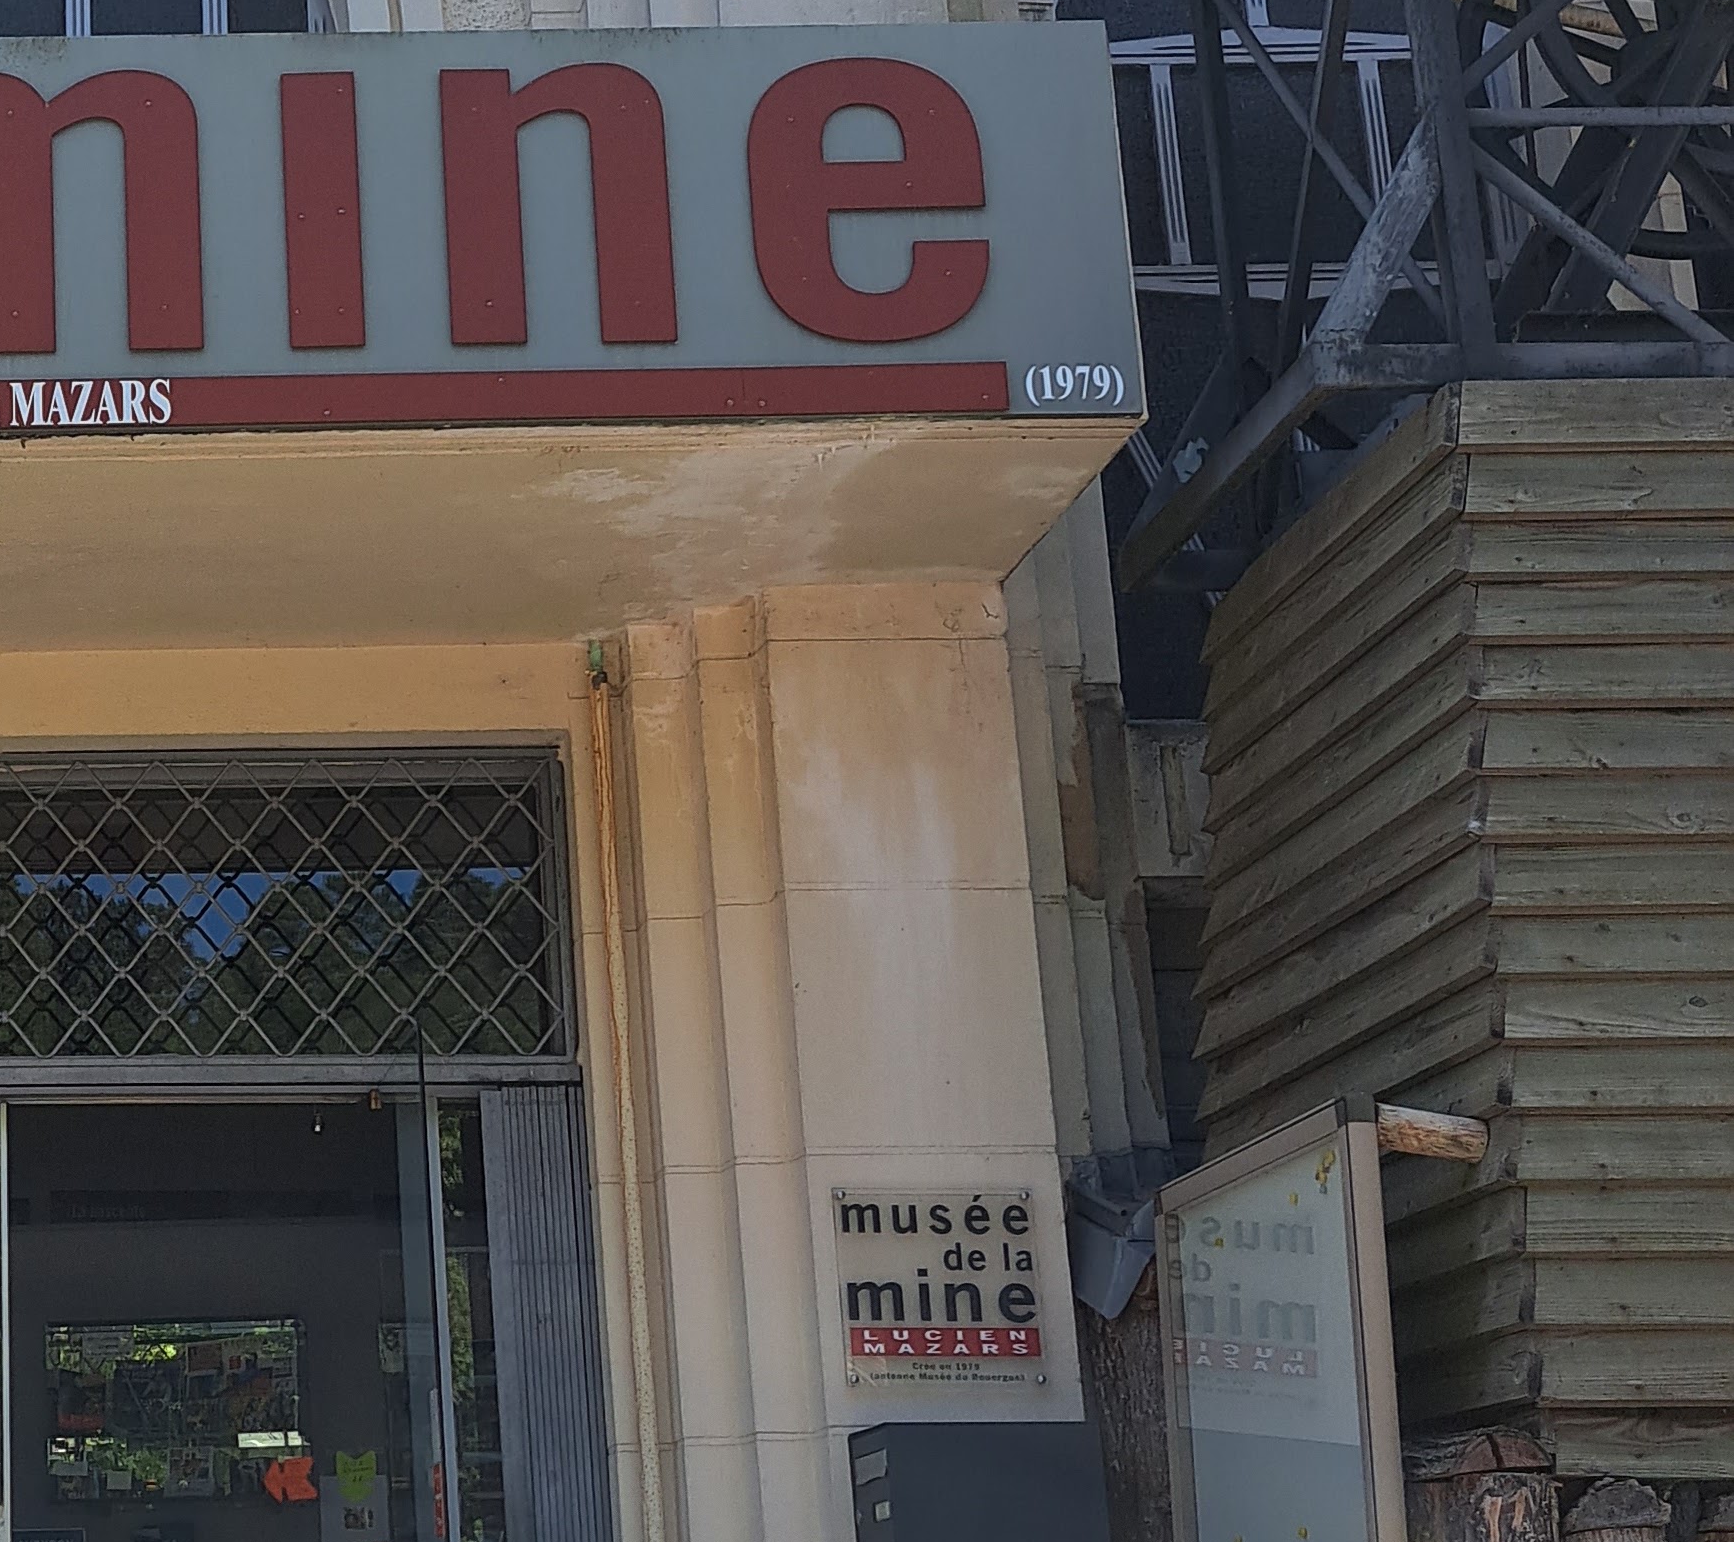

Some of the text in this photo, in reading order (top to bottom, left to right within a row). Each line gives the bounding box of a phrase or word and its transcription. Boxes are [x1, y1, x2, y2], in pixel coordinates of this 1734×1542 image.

[9, 378, 172, 426] MAZARS
[1025, 364, 1125, 407] (1979)
[840, 1195, 1029, 1235] musée
[943, 1242, 1033, 1271] de la
[847, 1268, 1037, 1323] mine
[863, 1329, 1027, 1341] LUCIEN
[863, 1343, 1029, 1354] MAZARS
